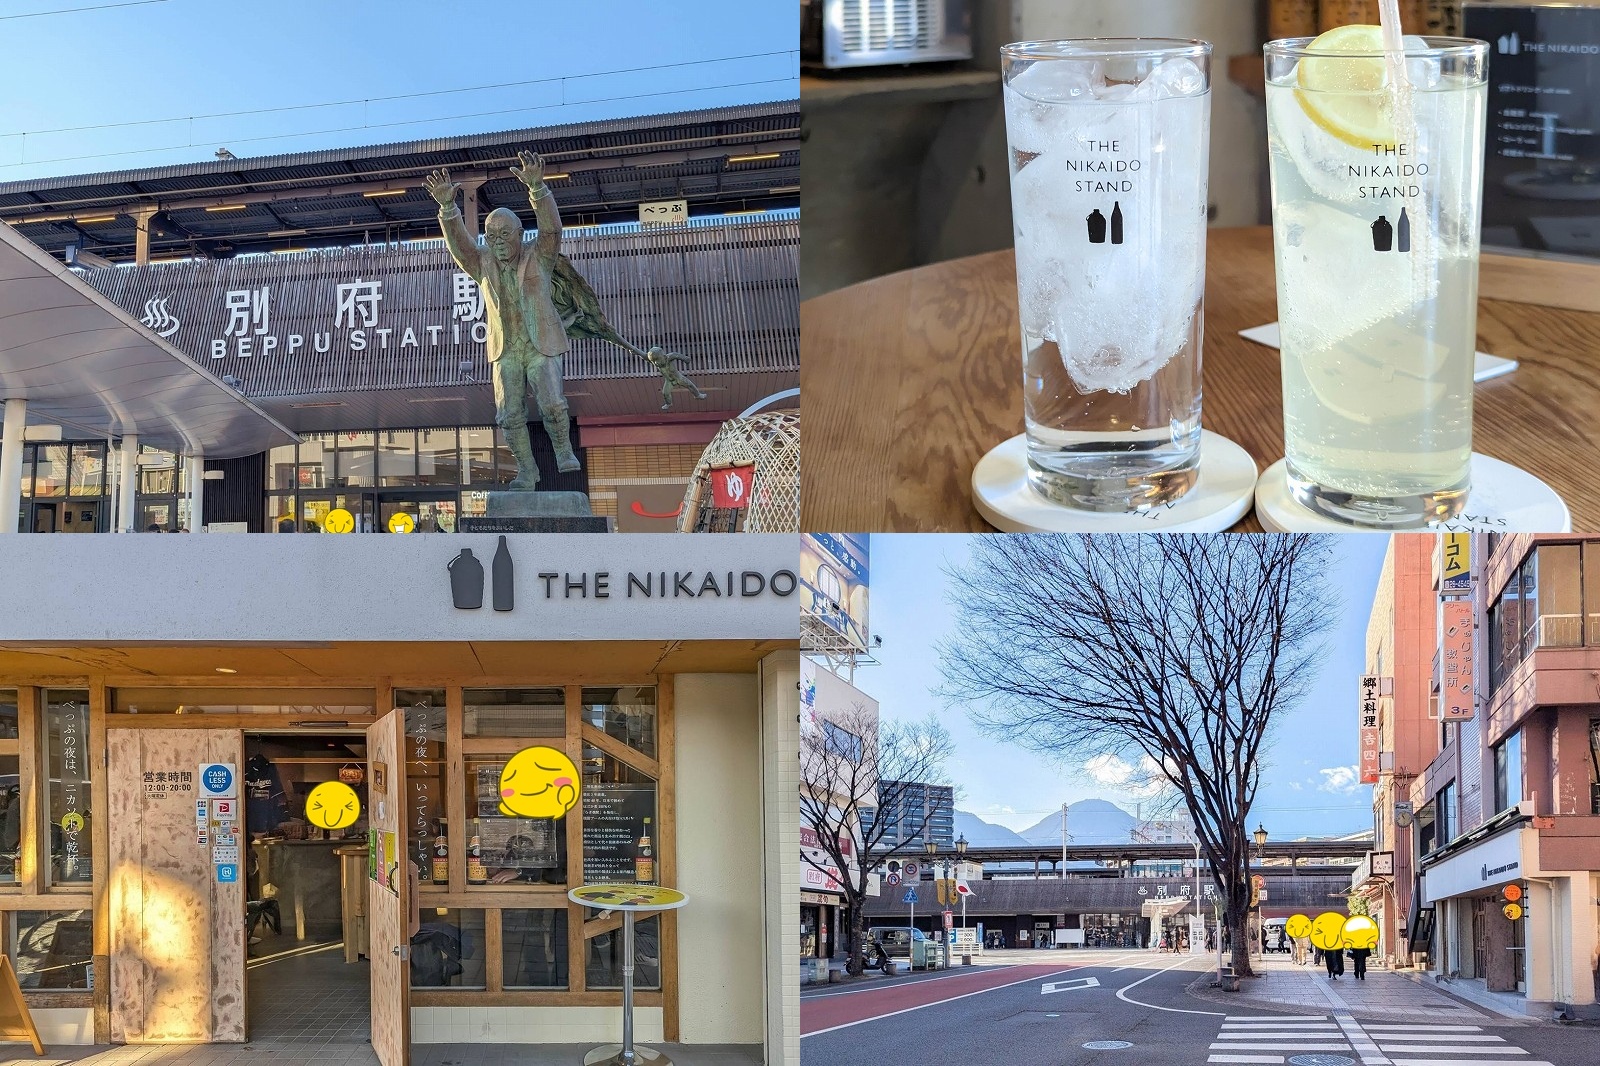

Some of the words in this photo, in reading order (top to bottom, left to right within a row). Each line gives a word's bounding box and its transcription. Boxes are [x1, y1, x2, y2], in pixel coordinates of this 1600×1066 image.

[1523, 43, 1544, 52] THE
[1547, 44, 1600, 55] NIKAIDO
[1087, 140, 1120, 152] THE
[1371, 143, 1407, 156] THE
[1066, 159, 1141, 173] NIKAIDO
[1348, 163, 1429, 178] NIKAIDO
[1075, 180, 1133, 193] STAND
[1359, 185, 1420, 199] STAND
[644, 203, 682, 213] べっぷ
[224, 272, 485, 337] 別府駅
[211, 331, 331, 359] BEPPU
[350, 320, 488, 351] STATIO
[725, 471, 743, 502] ゆ
[817, 533, 861, 575] っと、感動。
[538, 572, 610, 599] THE
[627, 569, 799, 598] NIKAIDO
[1363, 677, 1377, 727] 郷土料理
[1451, 706, 1469, 716] 3F
[1363, 732, 1377, 778] 吉四六
[143, 771, 192, 783] 営業時間
[208, 770, 228, 778] CASH
[144, 784, 191, 792] 12:00-20:00
[415, 700, 429, 880] べっぷの夜へ、いってらっしゃい。
[1157, 885, 1215, 896] 別府駅
